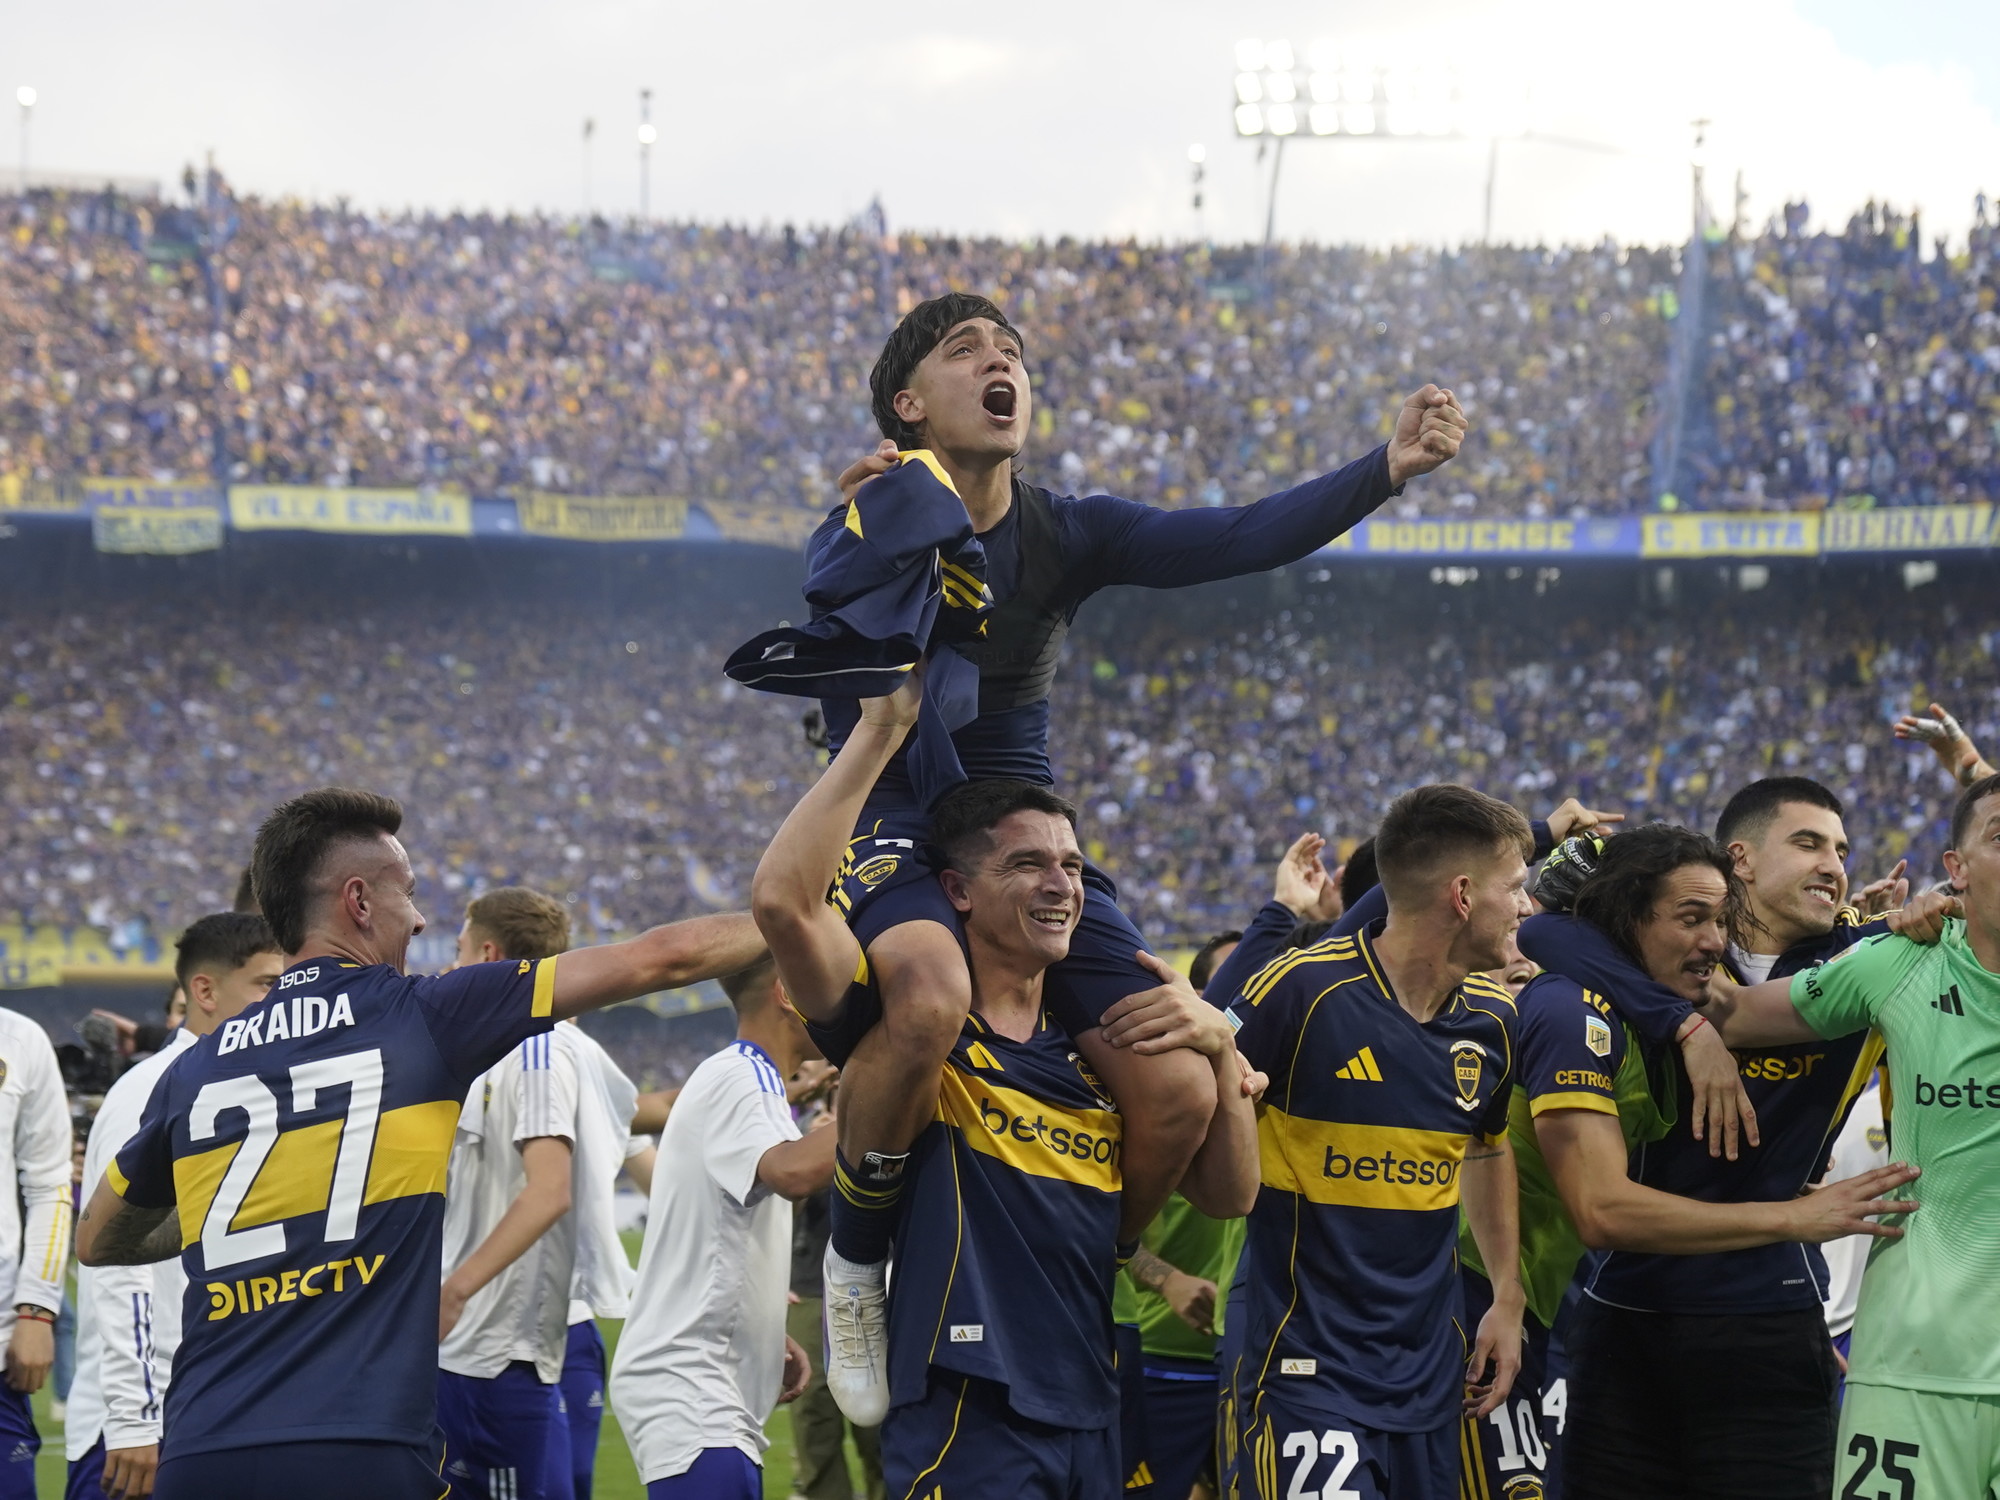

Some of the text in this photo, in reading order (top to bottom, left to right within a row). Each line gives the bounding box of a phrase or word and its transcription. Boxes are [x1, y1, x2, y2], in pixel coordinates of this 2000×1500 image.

[278, 966, 320, 991] 1905
[217, 992, 356, 1057] BRAIDA
[1458, 1068, 1476, 1079] CABJ
[1555, 1069, 1613, 1091] CETROG
[188, 1048, 384, 1272] 27
[206, 1254, 386, 1322] DIRECTV
[1282, 1429, 1360, 1500] 22
[1489, 1398, 1547, 1472] 10
[1840, 1432, 1920, 1500] 25
